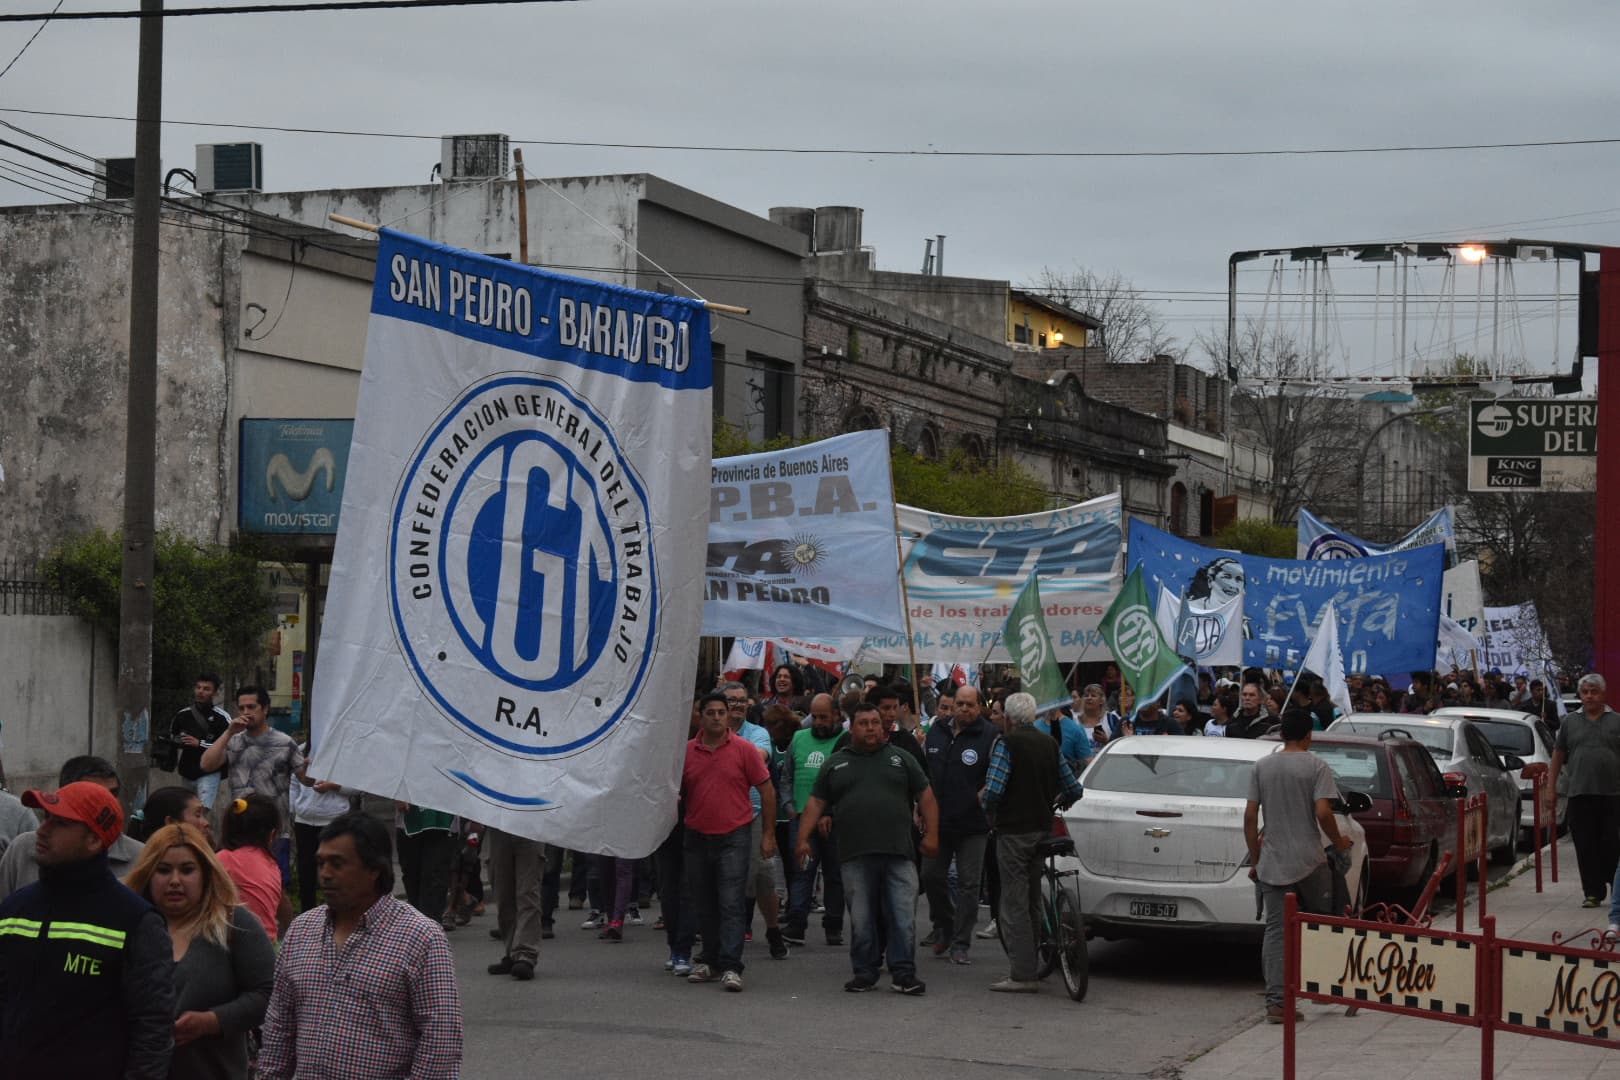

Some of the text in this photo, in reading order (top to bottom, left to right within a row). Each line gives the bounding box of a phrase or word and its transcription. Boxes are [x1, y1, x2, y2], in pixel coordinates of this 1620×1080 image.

[390, 253, 441, 312] SAN
[448, 269, 532, 336] PEDRO
[558, 296, 691, 374] BARADERO
[1516, 404, 1597, 427] SUPER
[1543, 430, 1588, 452] DEL
[711, 453, 849, 484] Provincia de Buenos Aires
[1497, 458, 1537, 470] KING
[264, 512, 336, 527] movistar
[408, 393, 643, 664] CONFEDERACION GENERAL DEL TRABAJO
[910, 603, 1104, 618] de los tradores
[863, 631, 935, 650] EGIONAL
[940, 631, 977, 649] SAN
[495, 696, 548, 737] R.A.
[63, 951, 102, 976] MTE
